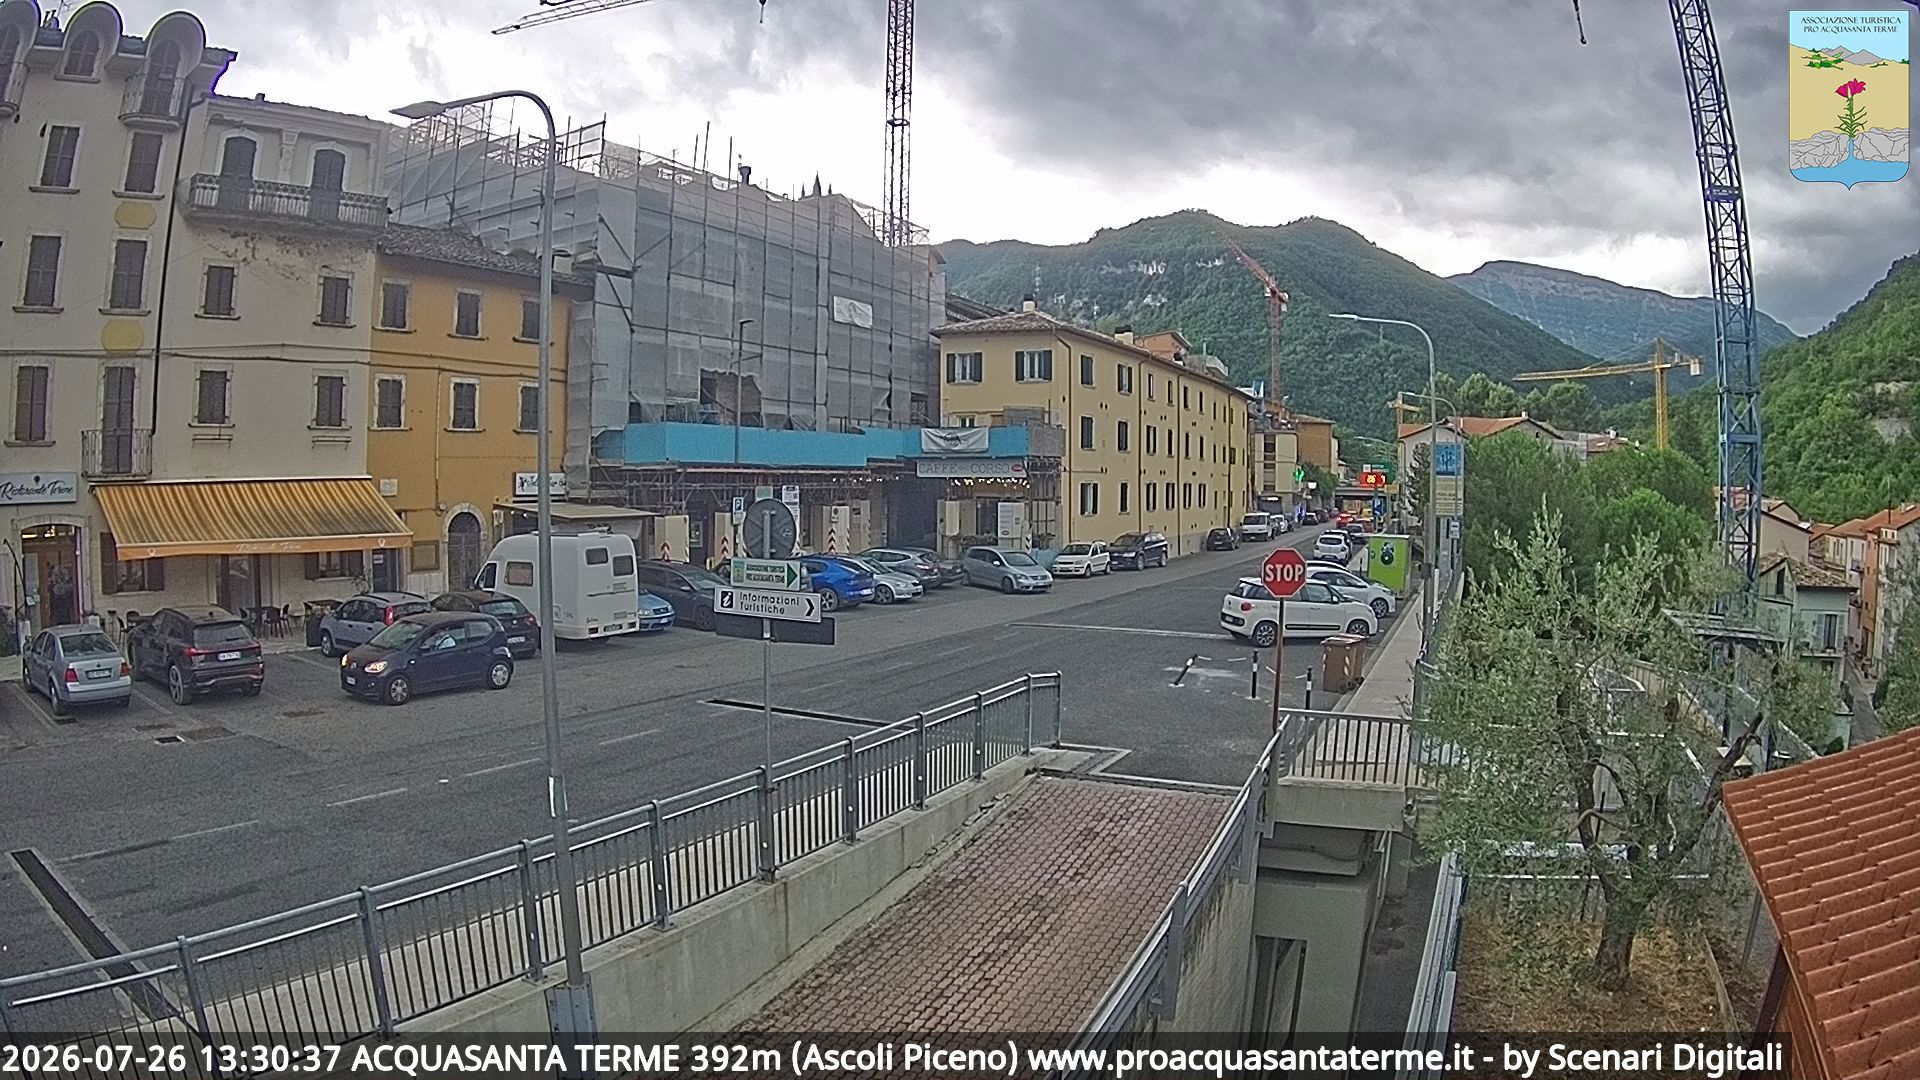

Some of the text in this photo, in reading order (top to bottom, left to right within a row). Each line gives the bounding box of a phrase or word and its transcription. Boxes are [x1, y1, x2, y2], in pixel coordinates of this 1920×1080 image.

[970, 463, 1010, 474] CORSO
[1264, 563, 1304, 582] STOP
[740, 591, 800, 606] Informazioni
[740, 602, 785, 615] Turistiche
